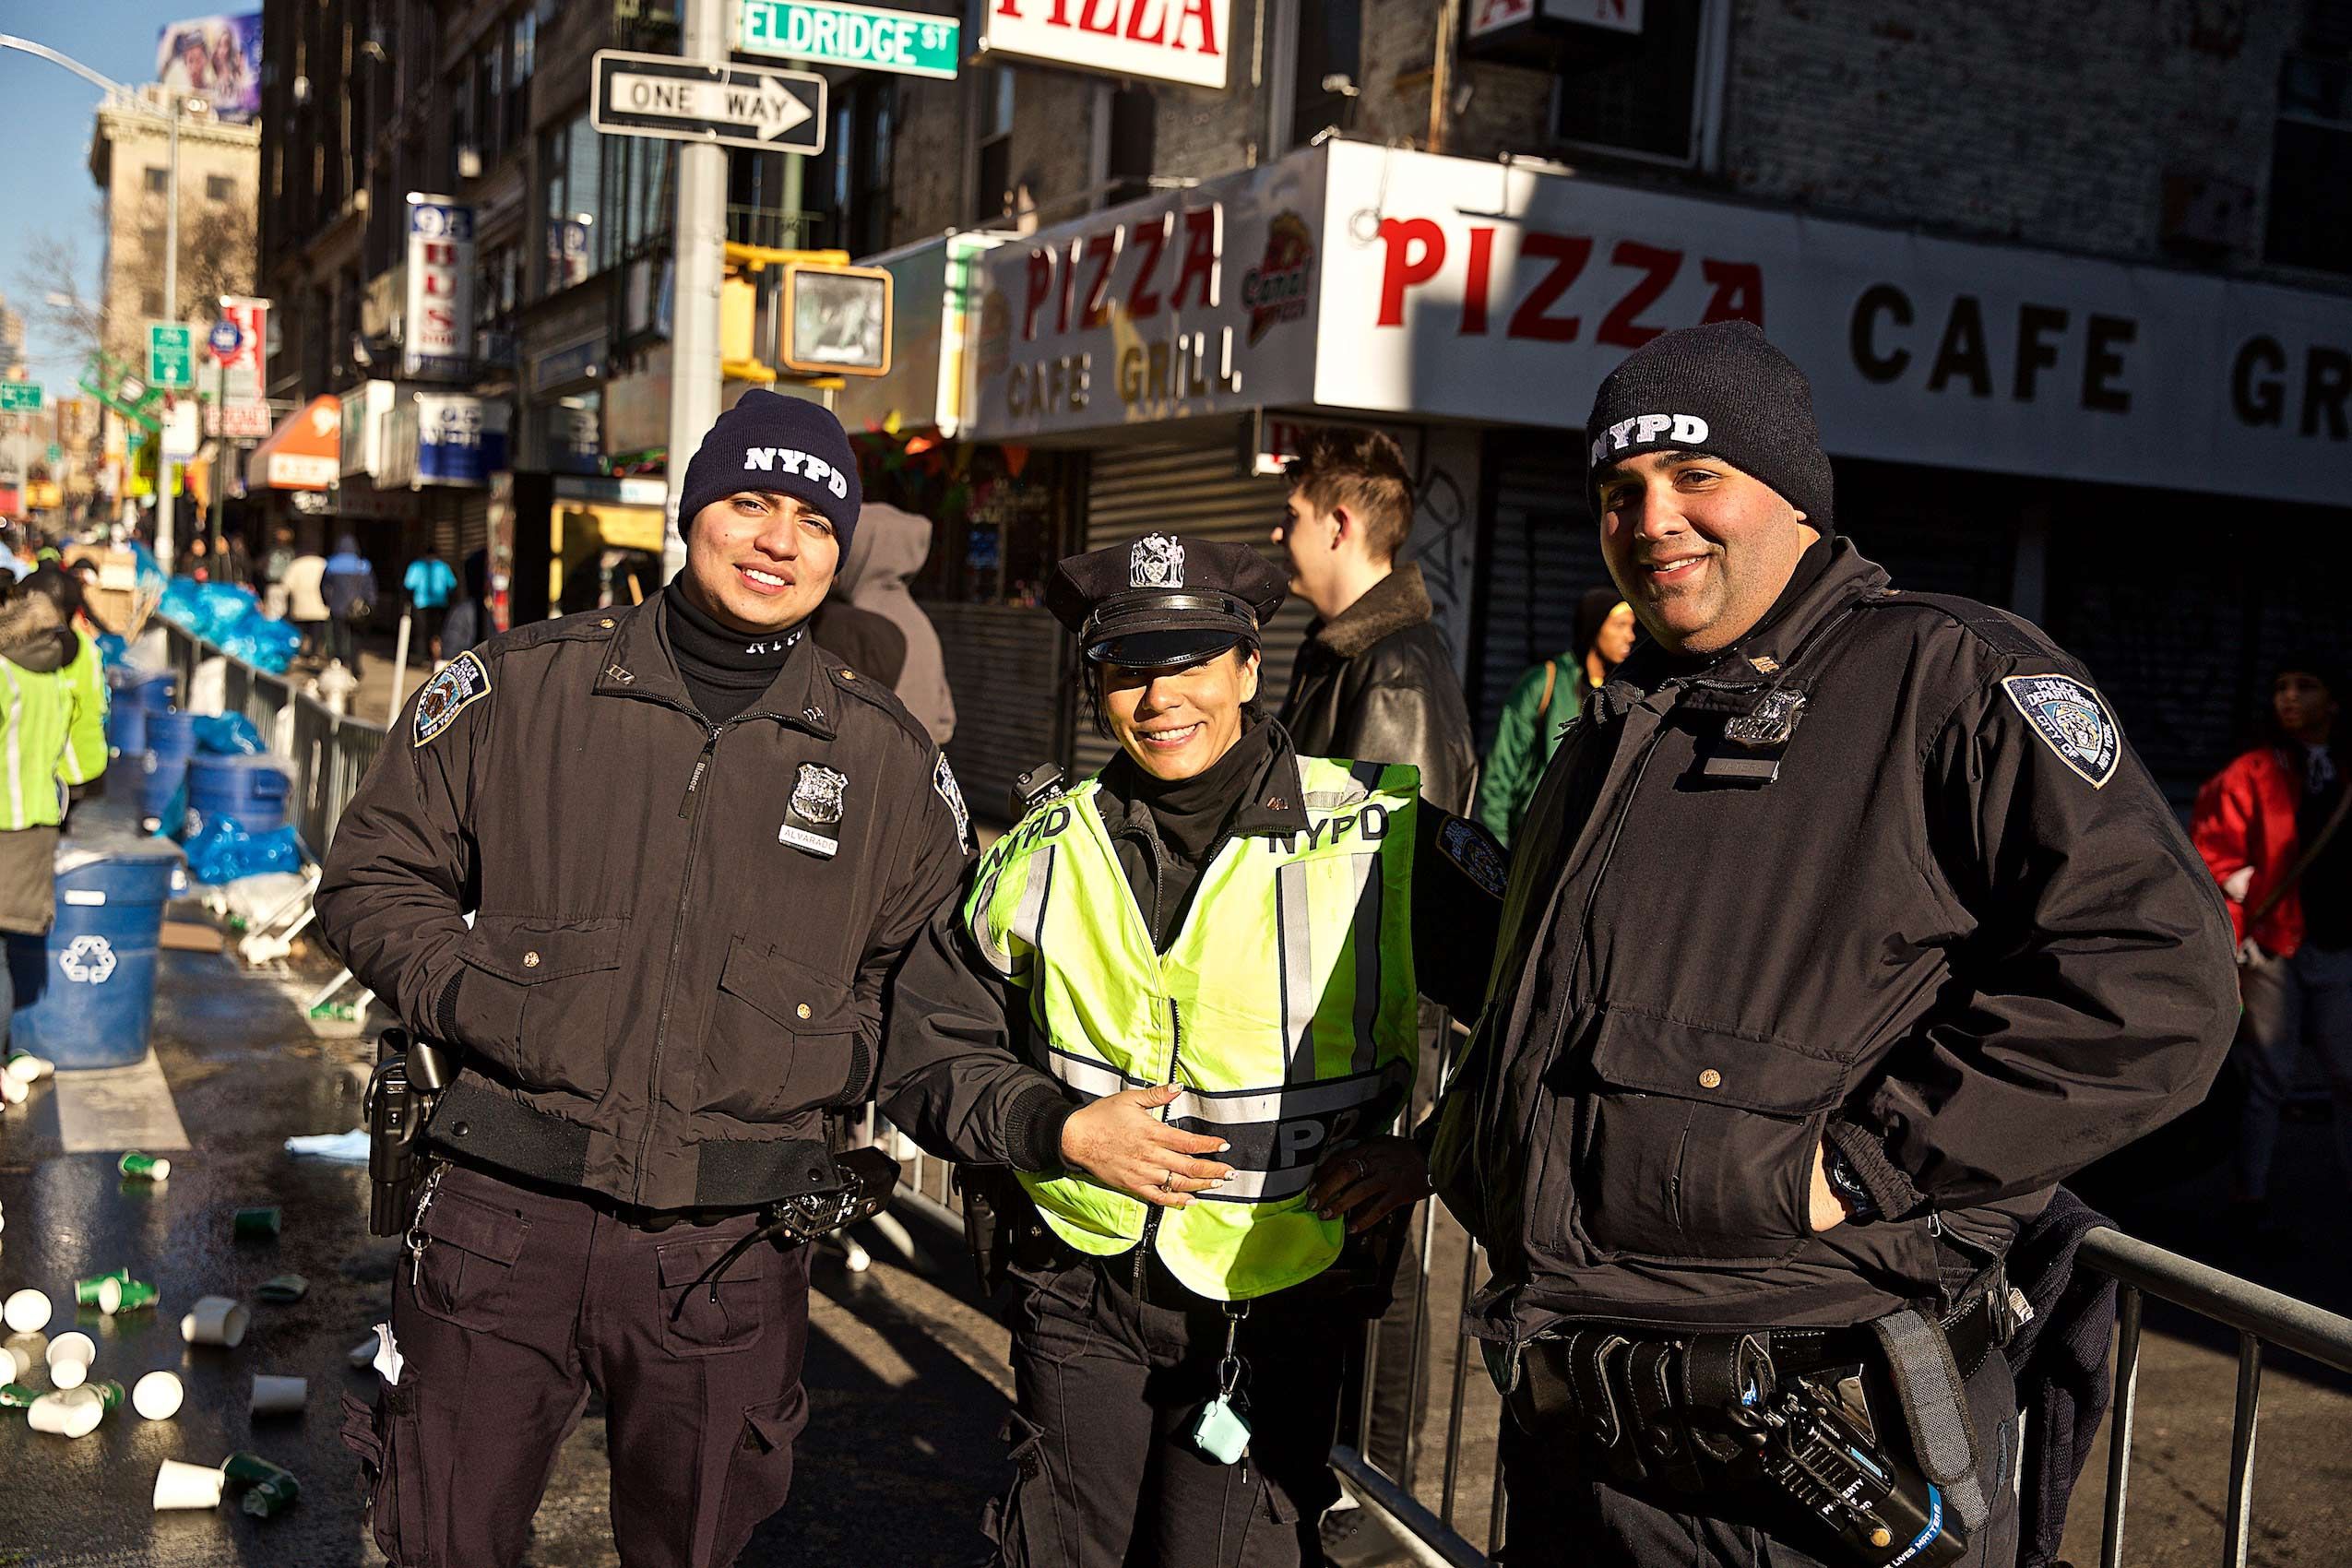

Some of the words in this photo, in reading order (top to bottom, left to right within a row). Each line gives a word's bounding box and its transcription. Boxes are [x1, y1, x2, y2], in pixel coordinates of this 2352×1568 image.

[744, 0, 918, 66] ELDRIDGE
[921, 23, 951, 51] ST
[631, 81, 694, 112] ONE
[725, 92, 789, 123] WAY
[1023, 202, 1224, 342] PIZZA
[1374, 217, 1764, 348] PIZZA
[1850, 283, 2137, 414] CAFE
[1007, 354, 1092, 416] CAFE
[1591, 413, 1709, 469] NYPD
[744, 446, 848, 500] NYPD
[2027, 688, 2101, 716] DEPARTMENT
[2033, 679, 2078, 695] POLICE
[2036, 715, 2062, 741] CITY
[2060, 742, 2081, 760] OF
[2096, 747, 2115, 772] NEW
[783, 828, 836, 851] ALVARADO
[1269, 803, 1389, 854] NYPD
[1822, 1478, 1864, 1515] POERTY
[1892, 1547, 1917, 1567] LIVES
